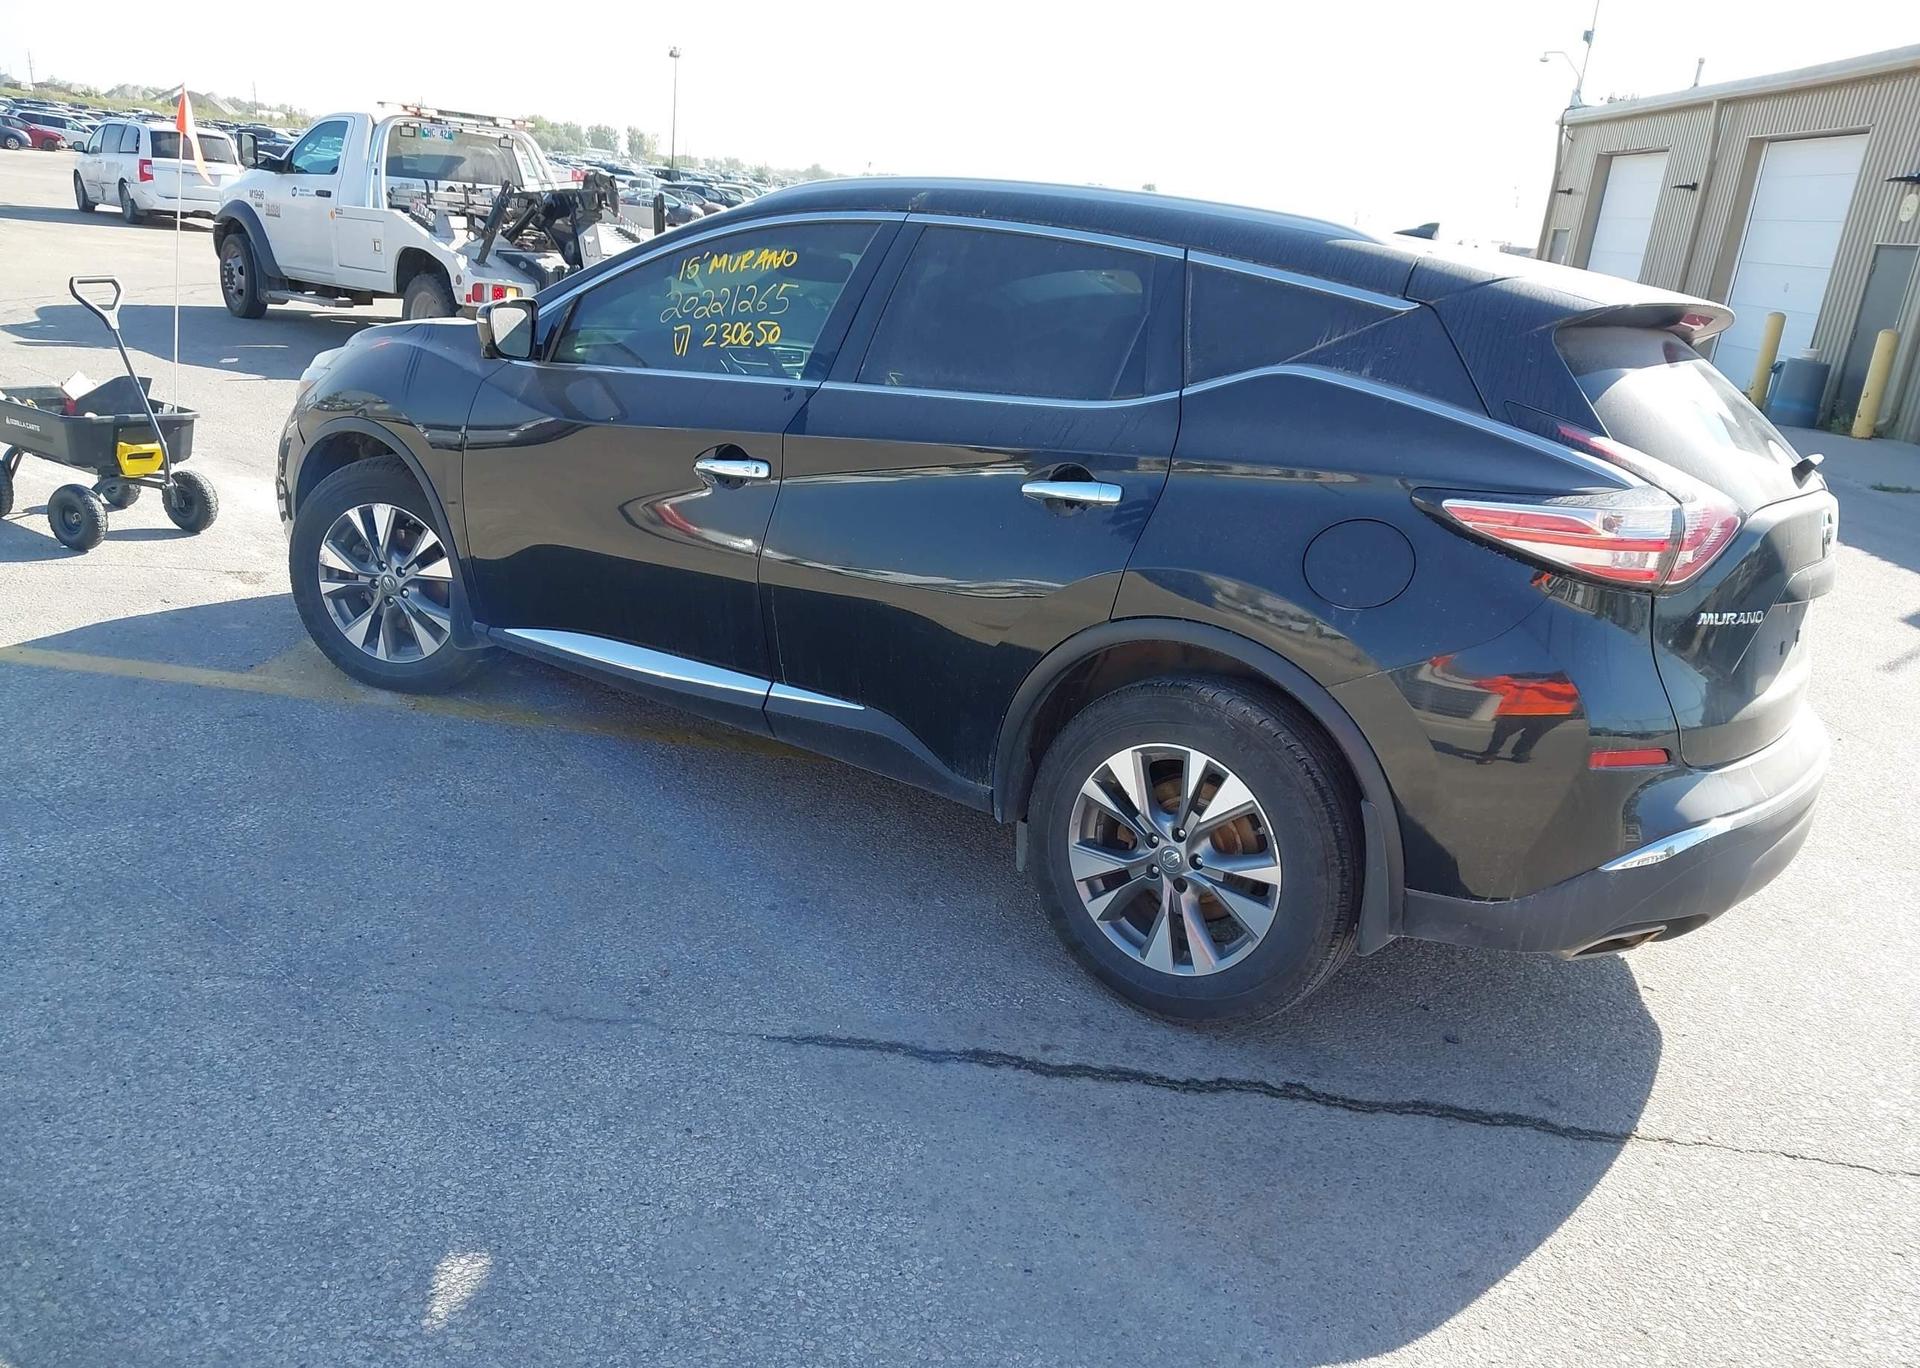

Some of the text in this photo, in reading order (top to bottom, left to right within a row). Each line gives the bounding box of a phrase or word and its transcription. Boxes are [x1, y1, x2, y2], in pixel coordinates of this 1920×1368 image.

[708, 248, 798, 274] MURANO
[660, 283, 799, 323] 20221265
[702, 320, 781, 347] 230650
[1697, 610, 1764, 625] MURANO
